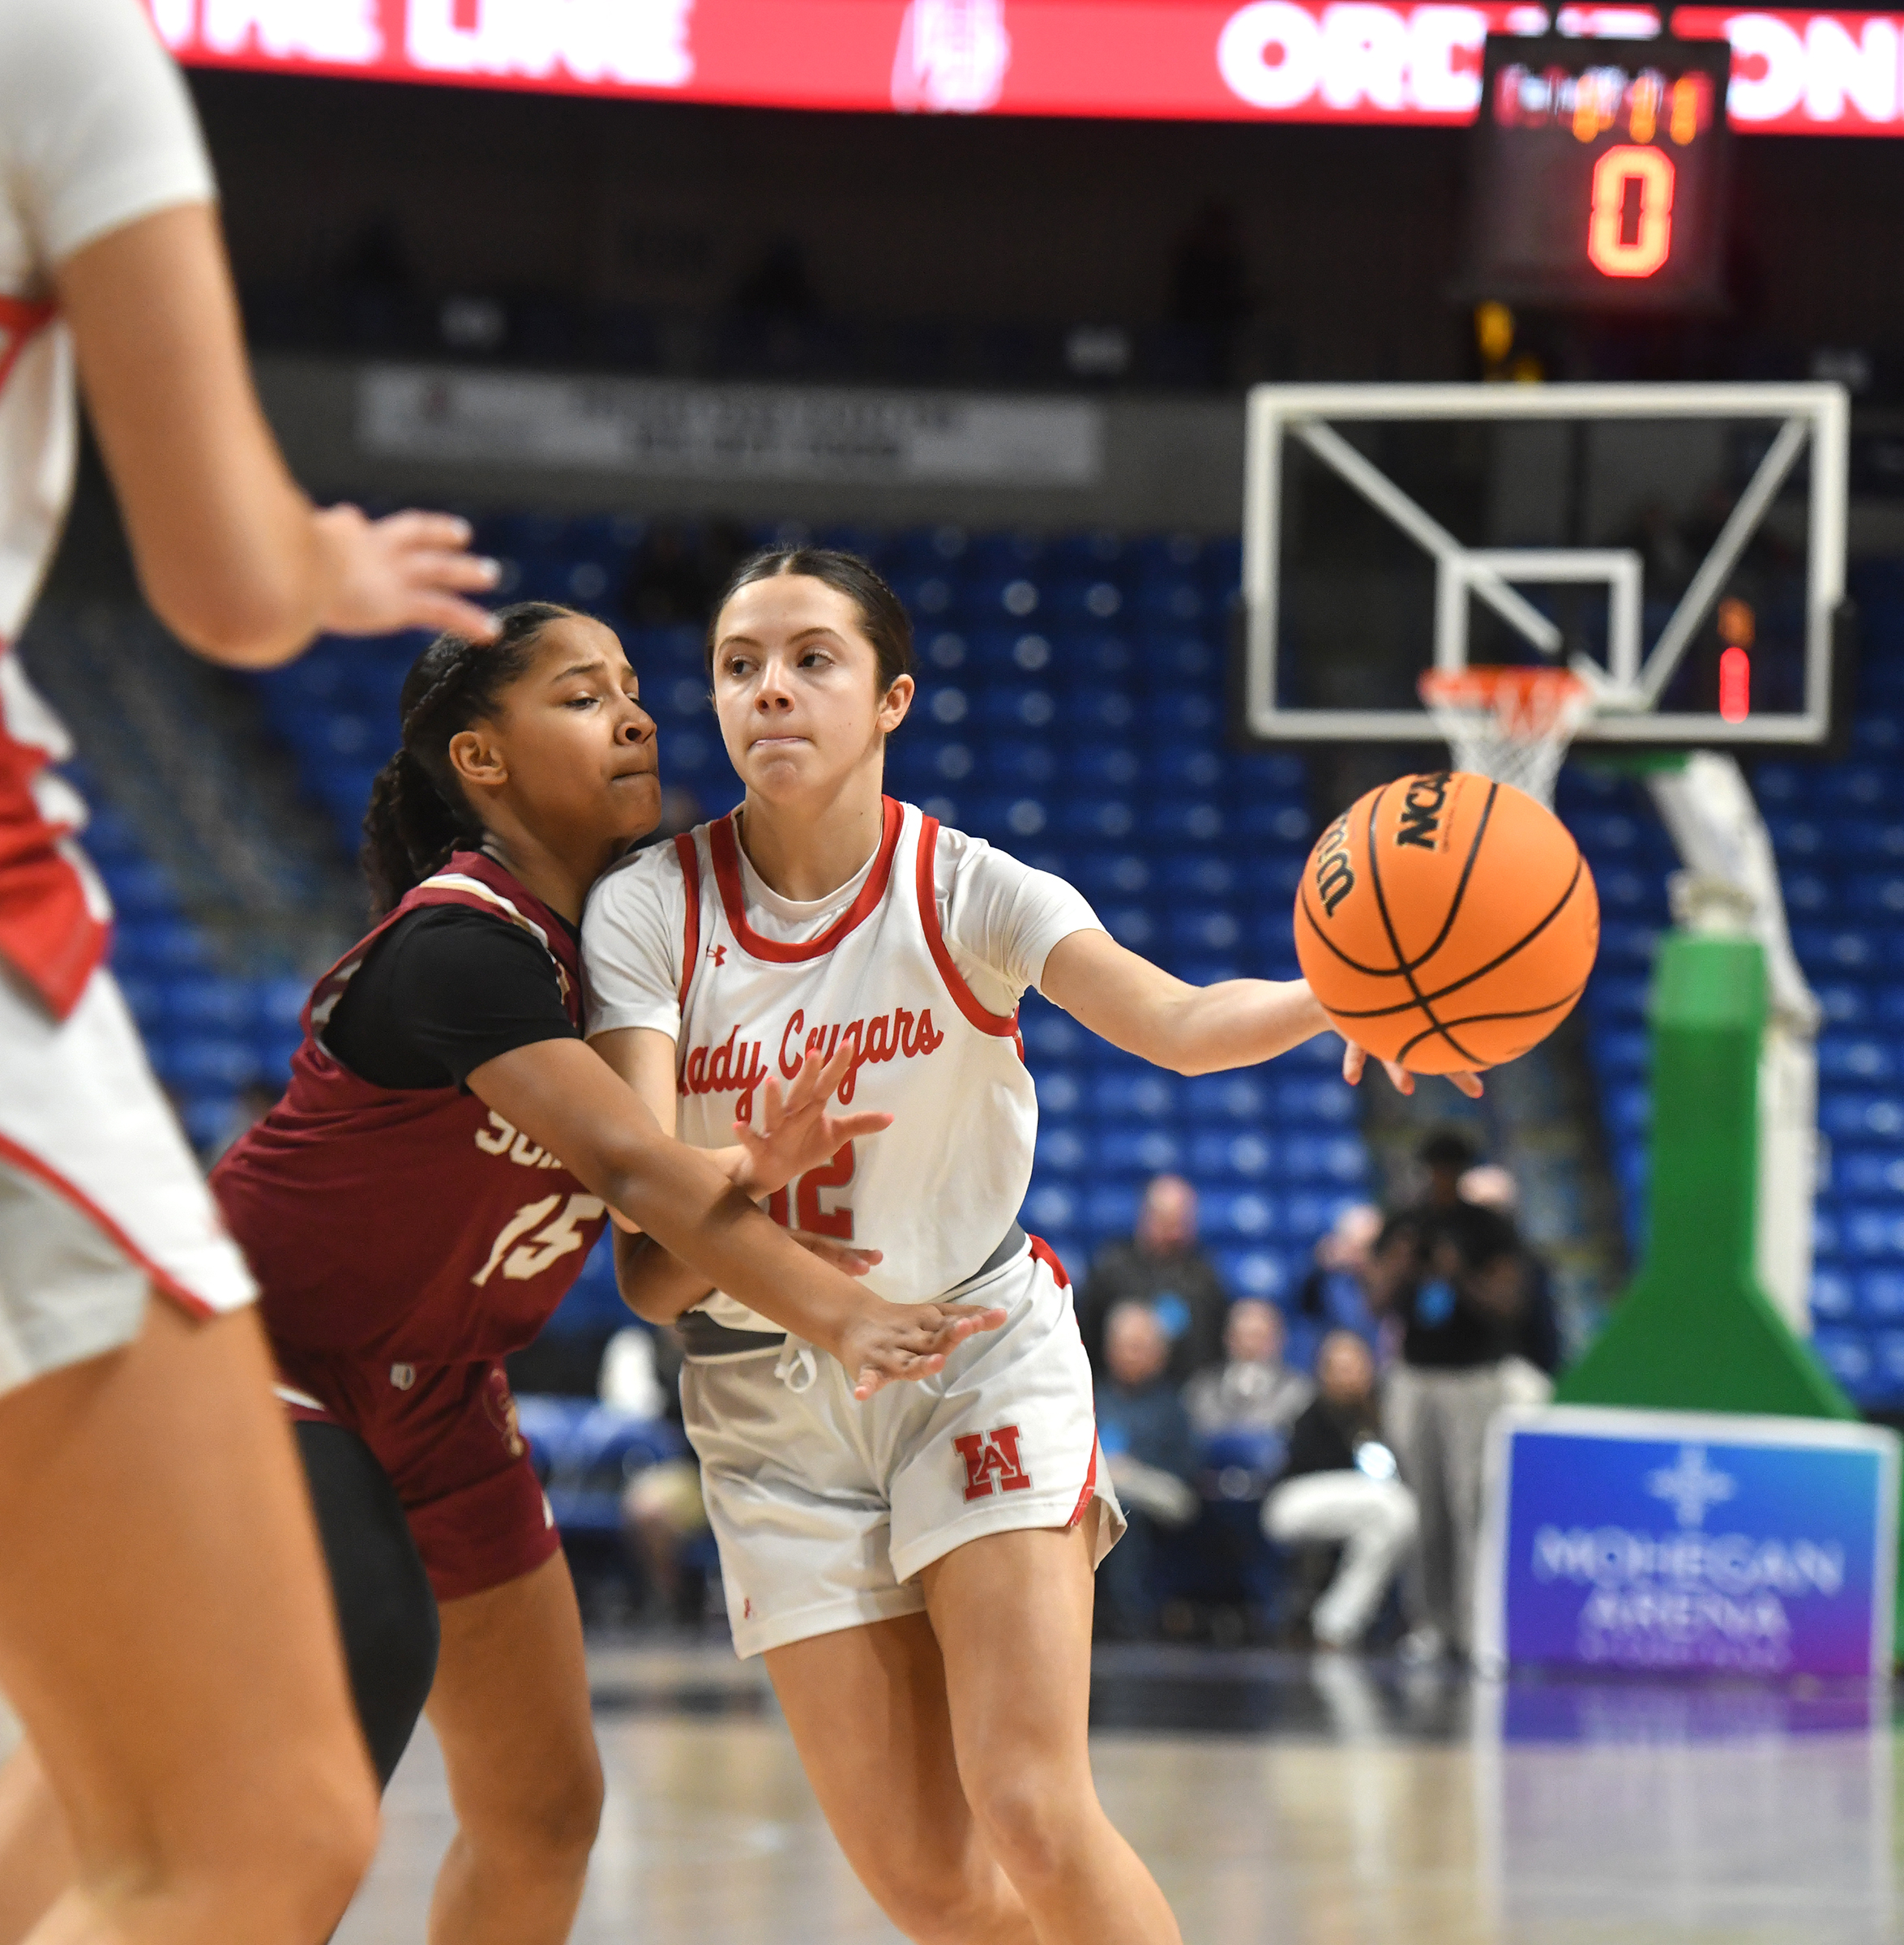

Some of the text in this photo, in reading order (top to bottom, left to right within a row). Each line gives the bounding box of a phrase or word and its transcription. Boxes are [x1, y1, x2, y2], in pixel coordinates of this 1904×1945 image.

[1587, 144, 1675, 277] 0
[681, 1024, 768, 1124] ady
[470, 1193, 605, 1287] 15
